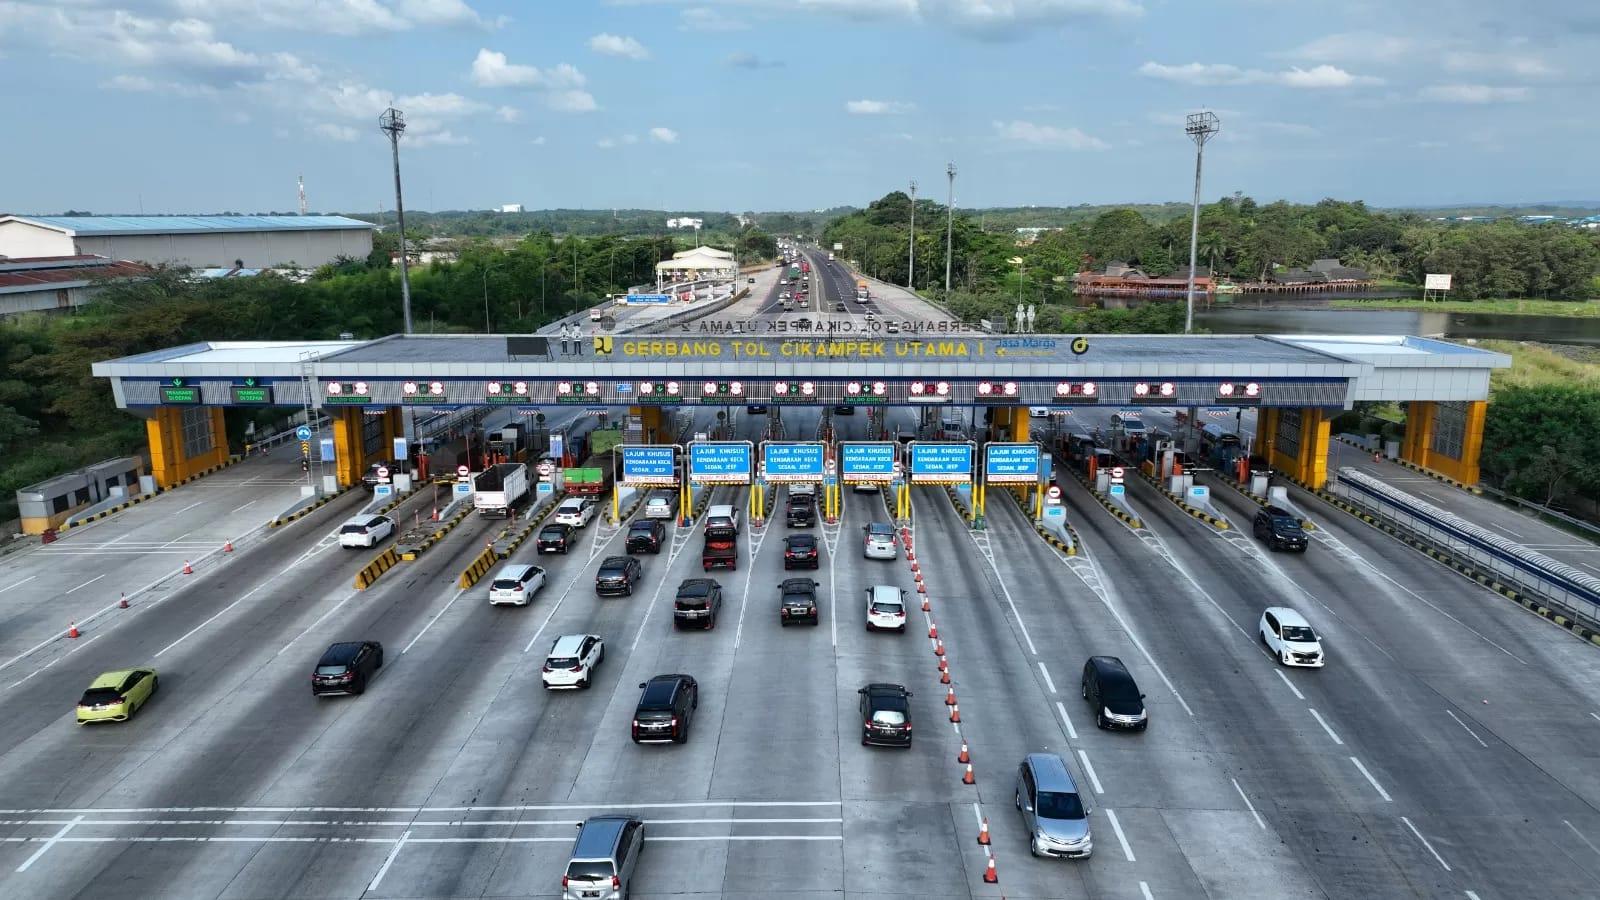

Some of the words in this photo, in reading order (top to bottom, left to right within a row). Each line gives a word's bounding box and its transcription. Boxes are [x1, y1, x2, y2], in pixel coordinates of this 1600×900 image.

[623, 341, 721, 356] GERBANG
[731, 342, 770, 356] TOL
[782, 341, 885, 357] CIKAMPEK
[895, 341, 968, 356] UTAMA
[998, 338, 1020, 347] Jasa
[1023, 338, 1056, 349] Marga
